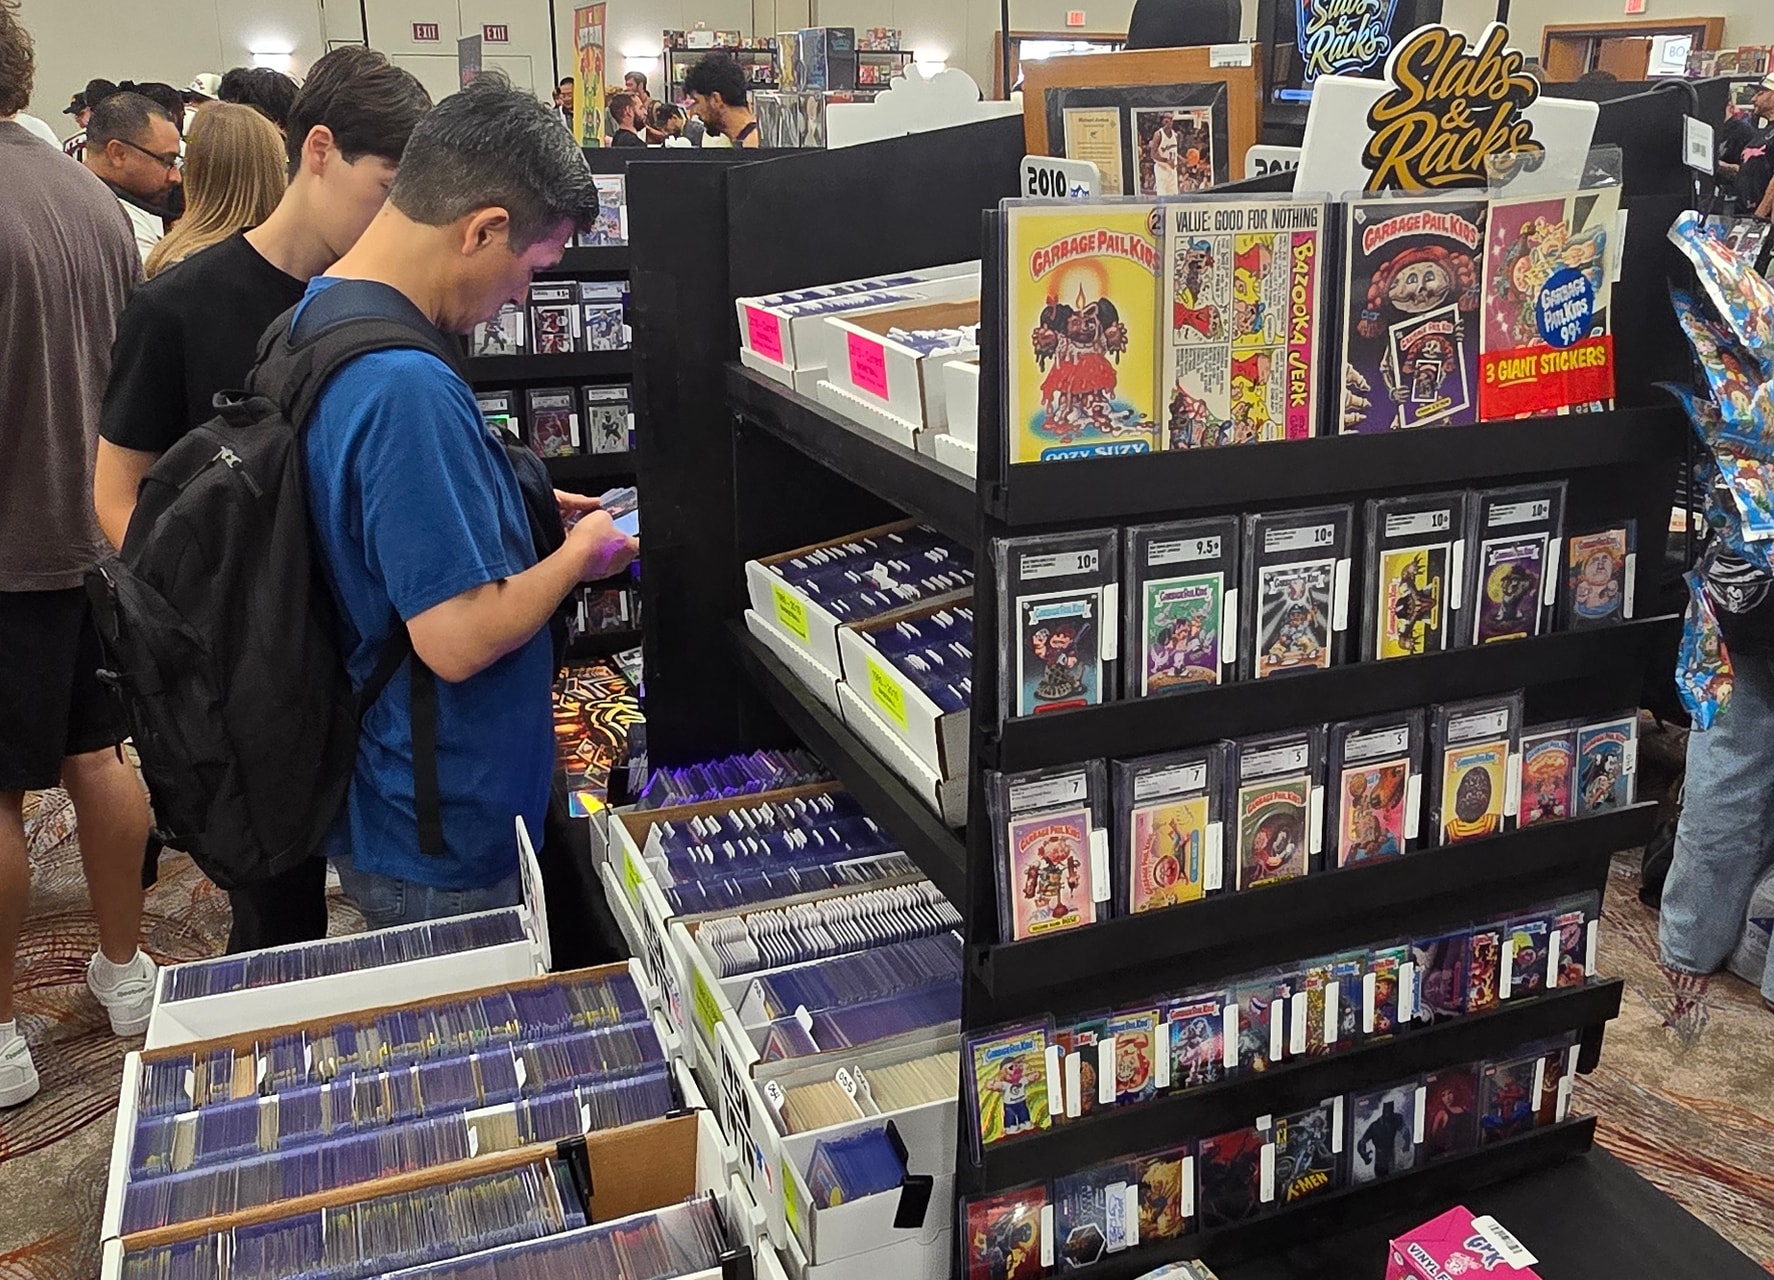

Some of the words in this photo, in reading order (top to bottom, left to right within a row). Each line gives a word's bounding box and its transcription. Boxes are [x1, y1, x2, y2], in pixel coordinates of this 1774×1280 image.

[416, 26, 436, 39] EXIT
[487, 26, 506, 40] EXIT
[1336, 15, 1354, 34] &
[1306, 13, 1388, 75] Racks
[1372, 24, 1535, 120] Slabs
[1440, 98, 1476, 130] &
[1369, 102, 1544, 195] Racks
[1028, 166, 1066, 197] 2010
[1176, 210, 1212, 233] VALUE:
[1214, 209, 1244, 231] GOOD
[1248, 208, 1268, 230] FOR
[1271, 207, 1318, 229] NOTHING
[1363, 215, 1422, 250] GARBAGE
[1421, 213, 1450, 232] PAIL
[1450, 217, 1478, 246] KIDS
[1031, 232, 1096, 276] GARBAGE
[1097, 230, 1129, 254] PAIL
[1128, 233, 1161, 272] KIDS
[1290, 240, 1314, 346] BAZOOKA
[1541, 276, 1587, 306] GARBAGE
[1543, 304, 1566, 332] PAIL
[1563, 299, 1588, 324] KIDS
[1485, 363, 1496, 383] 3
[1498, 357, 1538, 382] GIANT
[1540, 345, 1607, 375] STICKERS
[1287, 350, 1309, 409] JERK
[1431, 513, 1445, 528] 10
[1532, 504, 1544, 518] 10
[1196, 540, 1213, 556] 9.5
[1313, 529, 1327, 543] 10
[1077, 554, 1091, 569] 10
[1296, 752, 1301, 762] 5
[1073, 781, 1079, 793] 7
[1194, 770, 1200, 781] 7
[1409, 1244, 1439, 1275] VINYL
